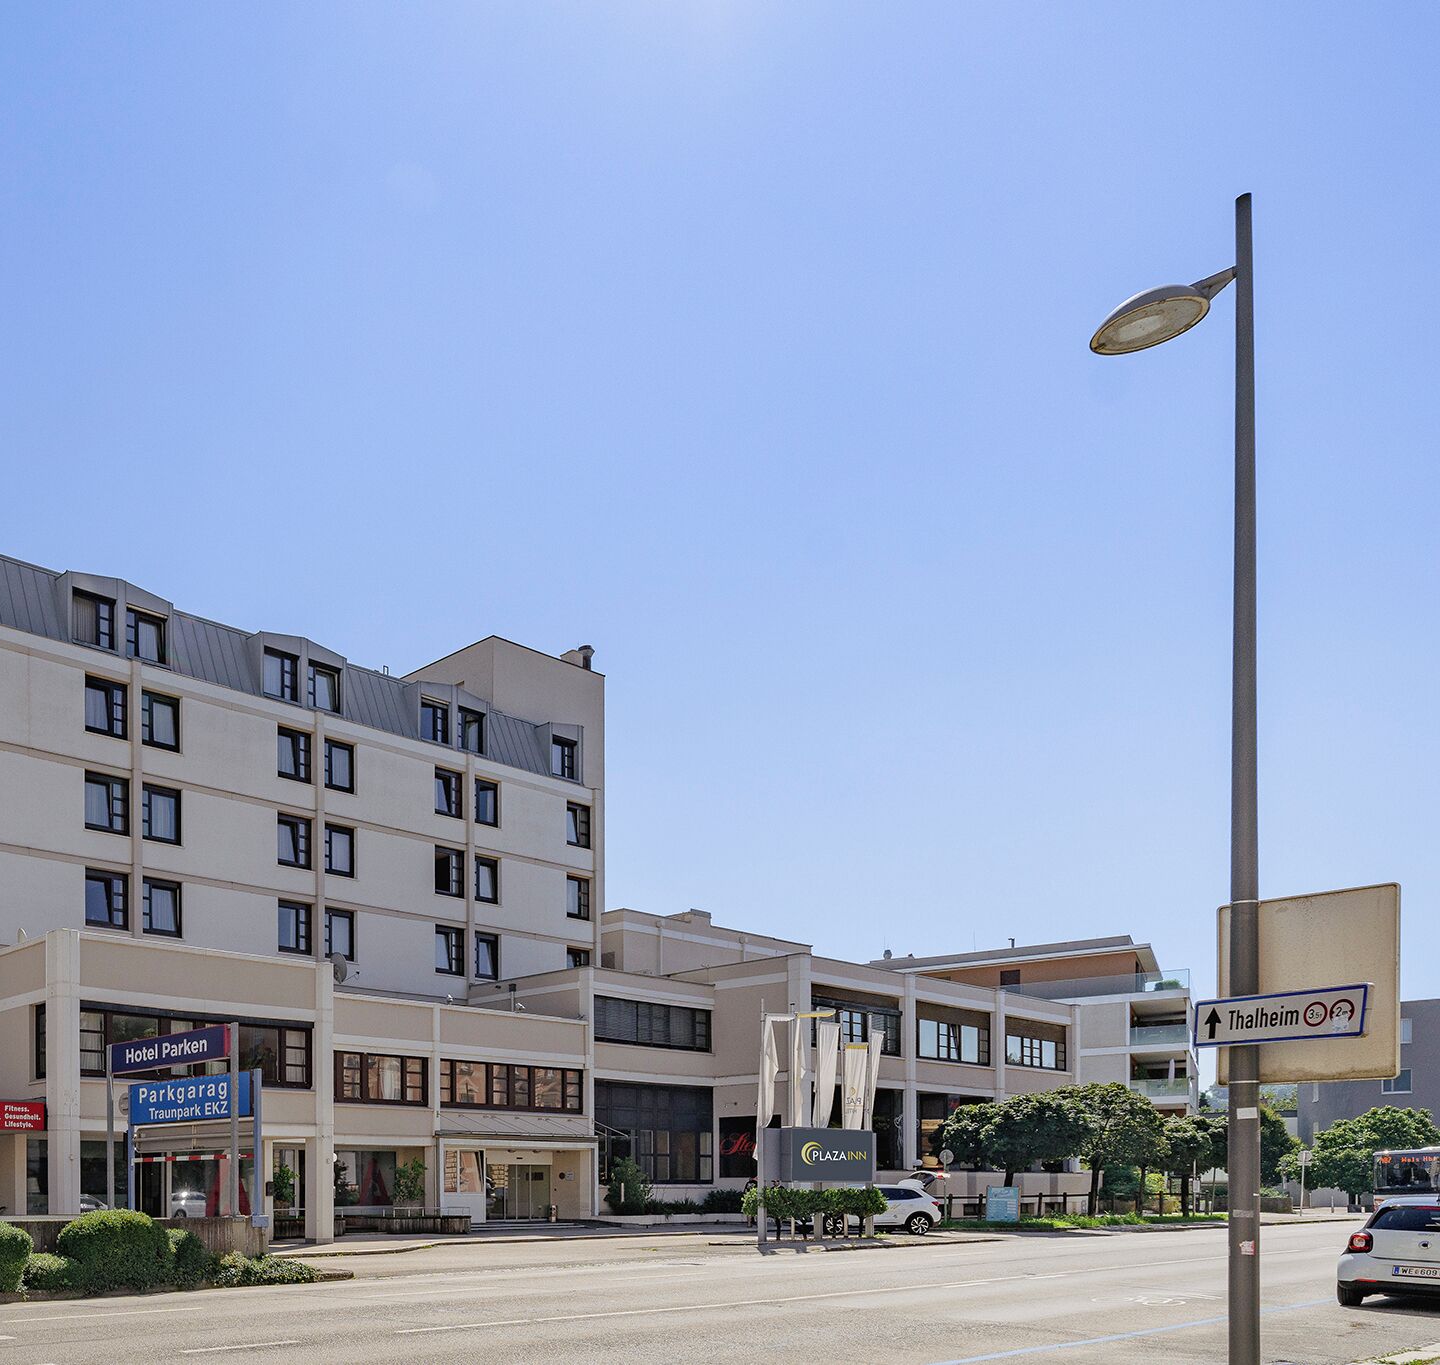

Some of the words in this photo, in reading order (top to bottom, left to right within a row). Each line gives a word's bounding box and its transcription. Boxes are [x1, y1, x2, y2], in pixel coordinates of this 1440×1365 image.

[1229, 1005, 1299, 1030] Thalheim
[125, 1043, 158, 1064] Hotel
[162, 1038, 208, 1058] Parken
[138, 1081, 228, 1104] Parkgarag
[4, 1113, 42, 1121] Gesundheit.
[149, 1103, 201, 1121] Traunpark
[204, 1100, 228, 1115] EKZ
[4, 1120, 34, 1128] Lifestyle.
